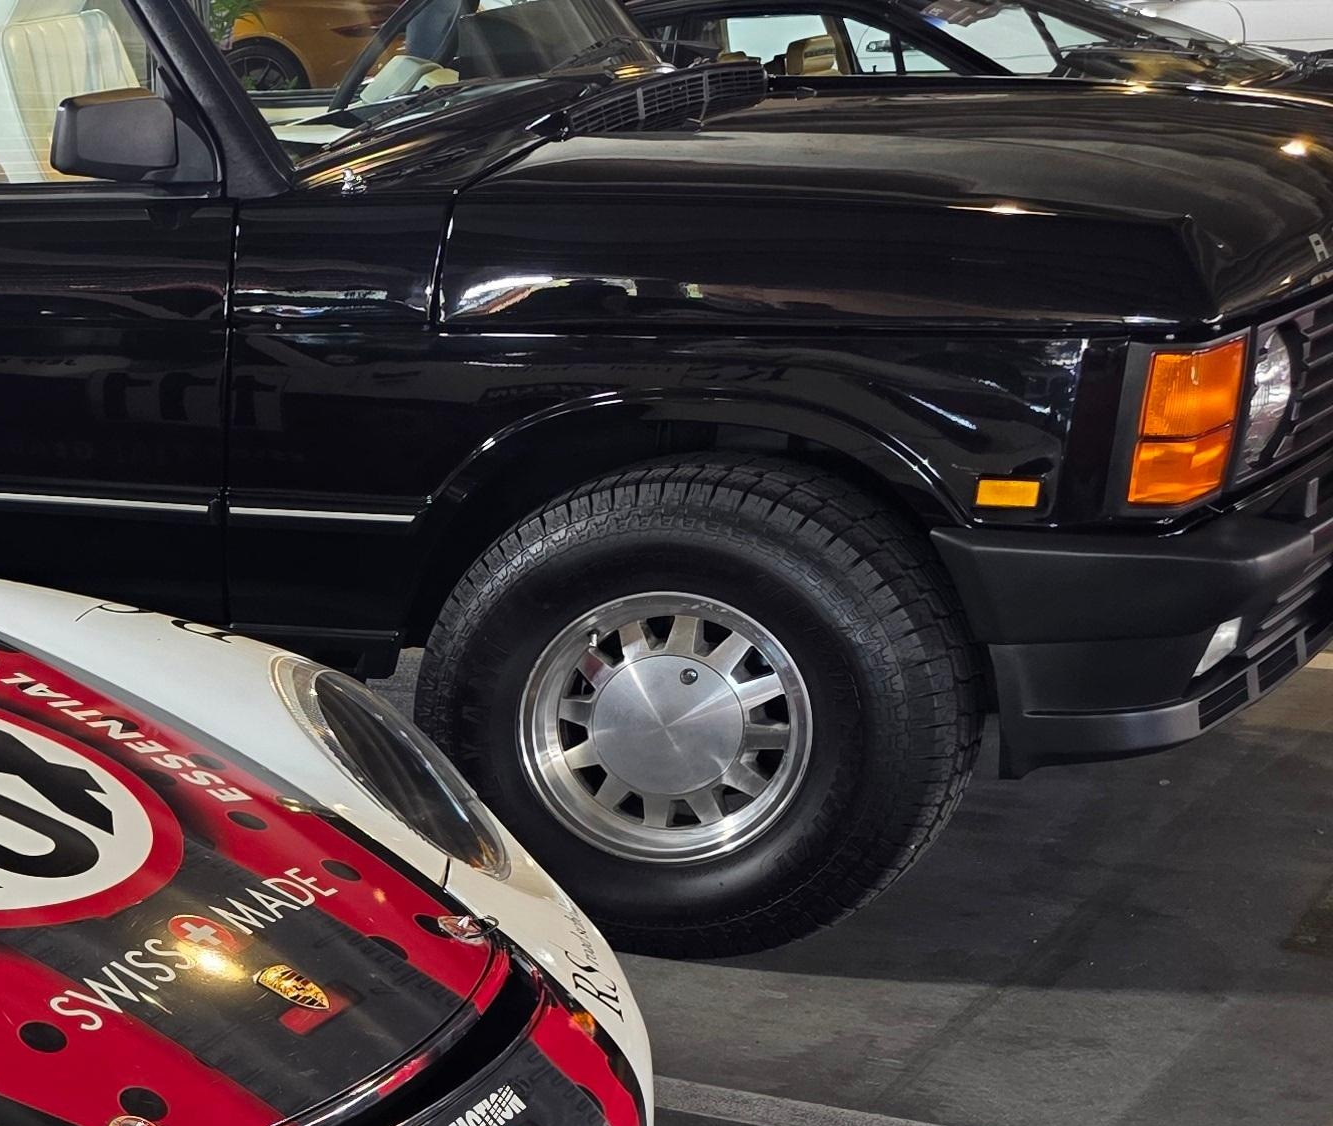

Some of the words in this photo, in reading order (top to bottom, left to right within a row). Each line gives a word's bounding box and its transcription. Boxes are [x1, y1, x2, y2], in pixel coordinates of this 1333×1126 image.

[0, 671, 253, 803] ESSENTIAL
[50, 931, 196, 1031] SWISS
[219, 866, 338, 937] MADE
